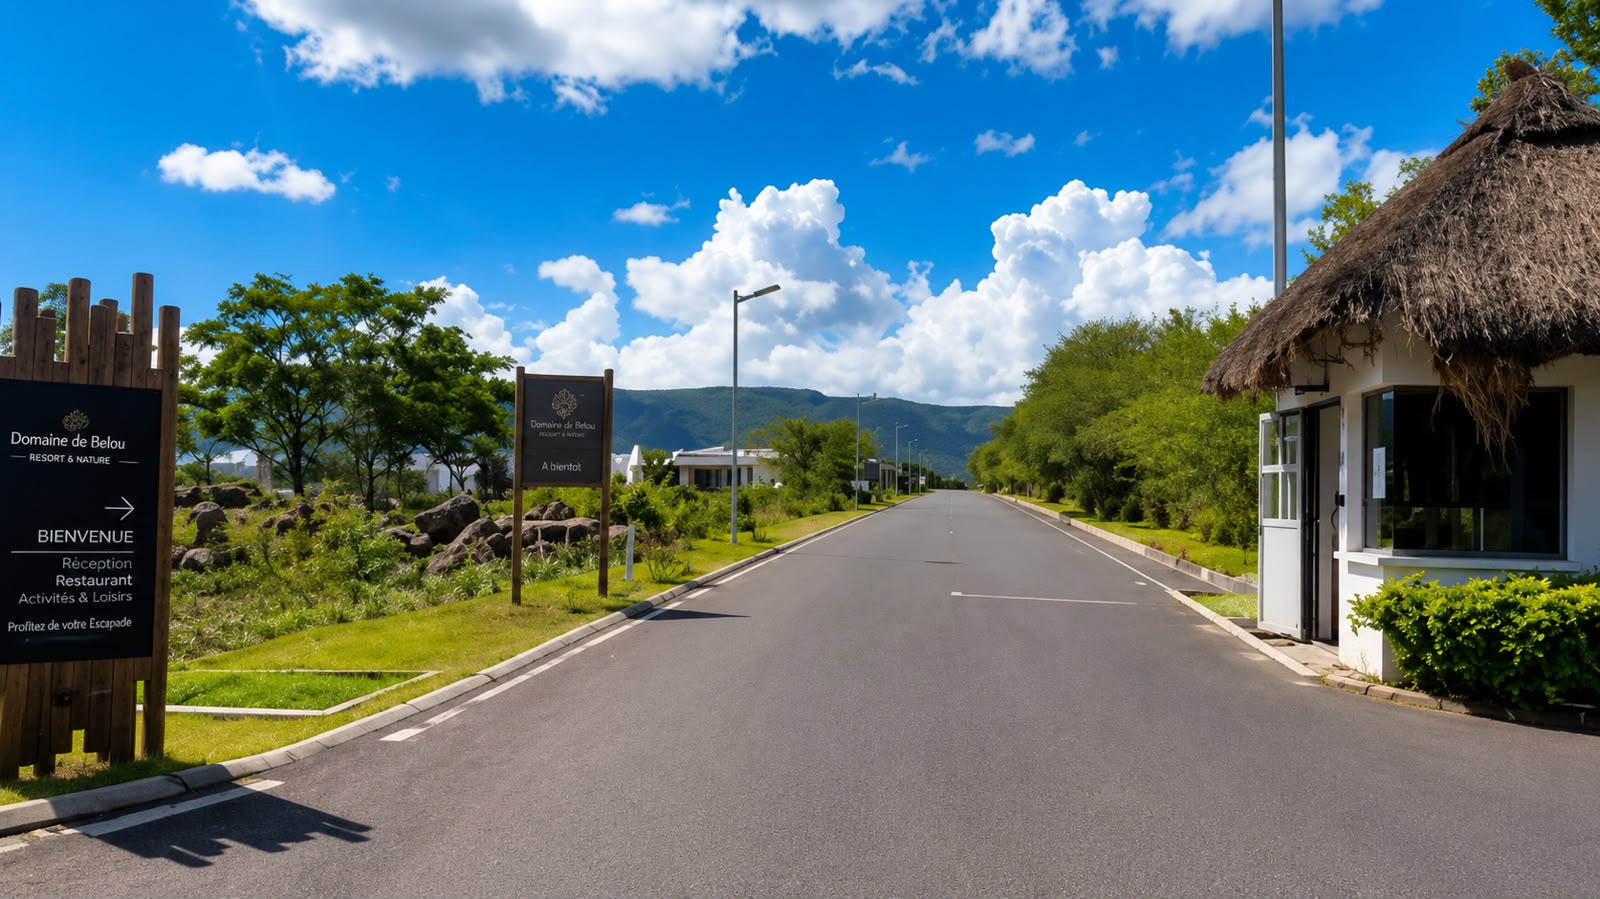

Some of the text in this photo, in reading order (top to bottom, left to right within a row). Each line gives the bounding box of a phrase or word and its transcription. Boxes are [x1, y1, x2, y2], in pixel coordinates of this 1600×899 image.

[10, 431, 126, 450] Domaine de Belou
[29, 453, 65, 463] RESORT
[76, 455, 111, 465] NATURE
[37, 529, 134, 544] BIENVENUE
[62, 556, 133, 572] Réception
[55, 574, 133, 587] Restaurant
[18, 591, 133, 605] Activités & Loisirs
[47, 619, 60, 631] de
[62, 619, 87, 630] votre
[89, 616, 132, 631] Escapade
